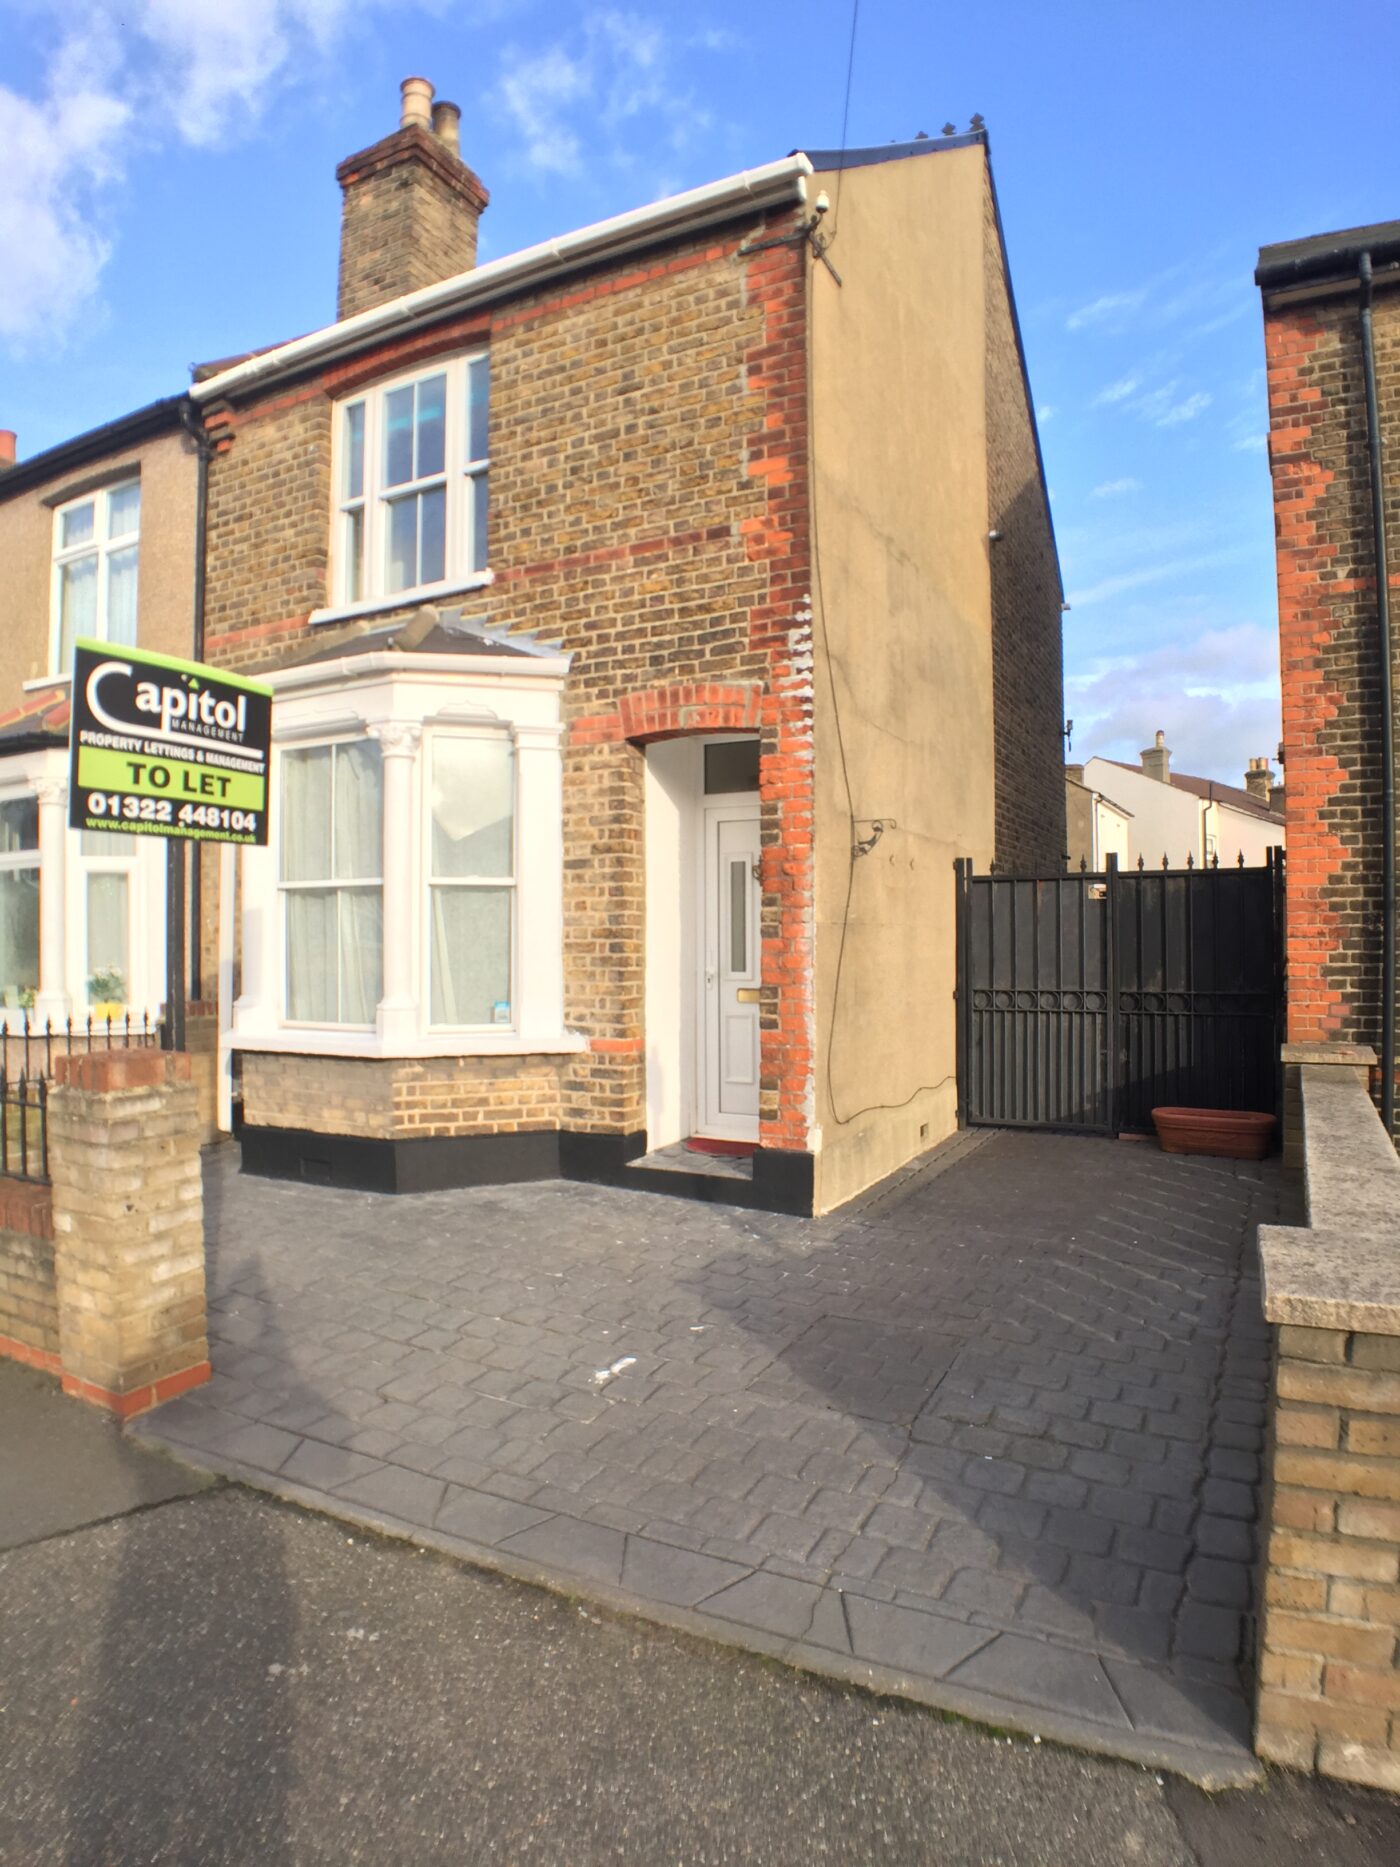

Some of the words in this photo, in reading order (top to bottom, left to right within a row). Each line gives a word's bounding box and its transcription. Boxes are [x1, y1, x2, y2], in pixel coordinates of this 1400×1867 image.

[86, 661, 247, 734] Capitol
[171, 718, 244, 742] MANAGEMENT
[80, 730, 142, 753] PROPERTY
[144, 740, 195, 762] LETTINGS
[196, 750, 204, 763] &
[206, 752, 265, 774] MANAGEMENT
[127, 761, 171, 789] TO
[183, 769, 231, 798] LET
[86, 817, 256, 844] www.capitolmanagement.co.uk
[87, 791, 173, 822] 01322
[178, 803, 256, 832] 448104
